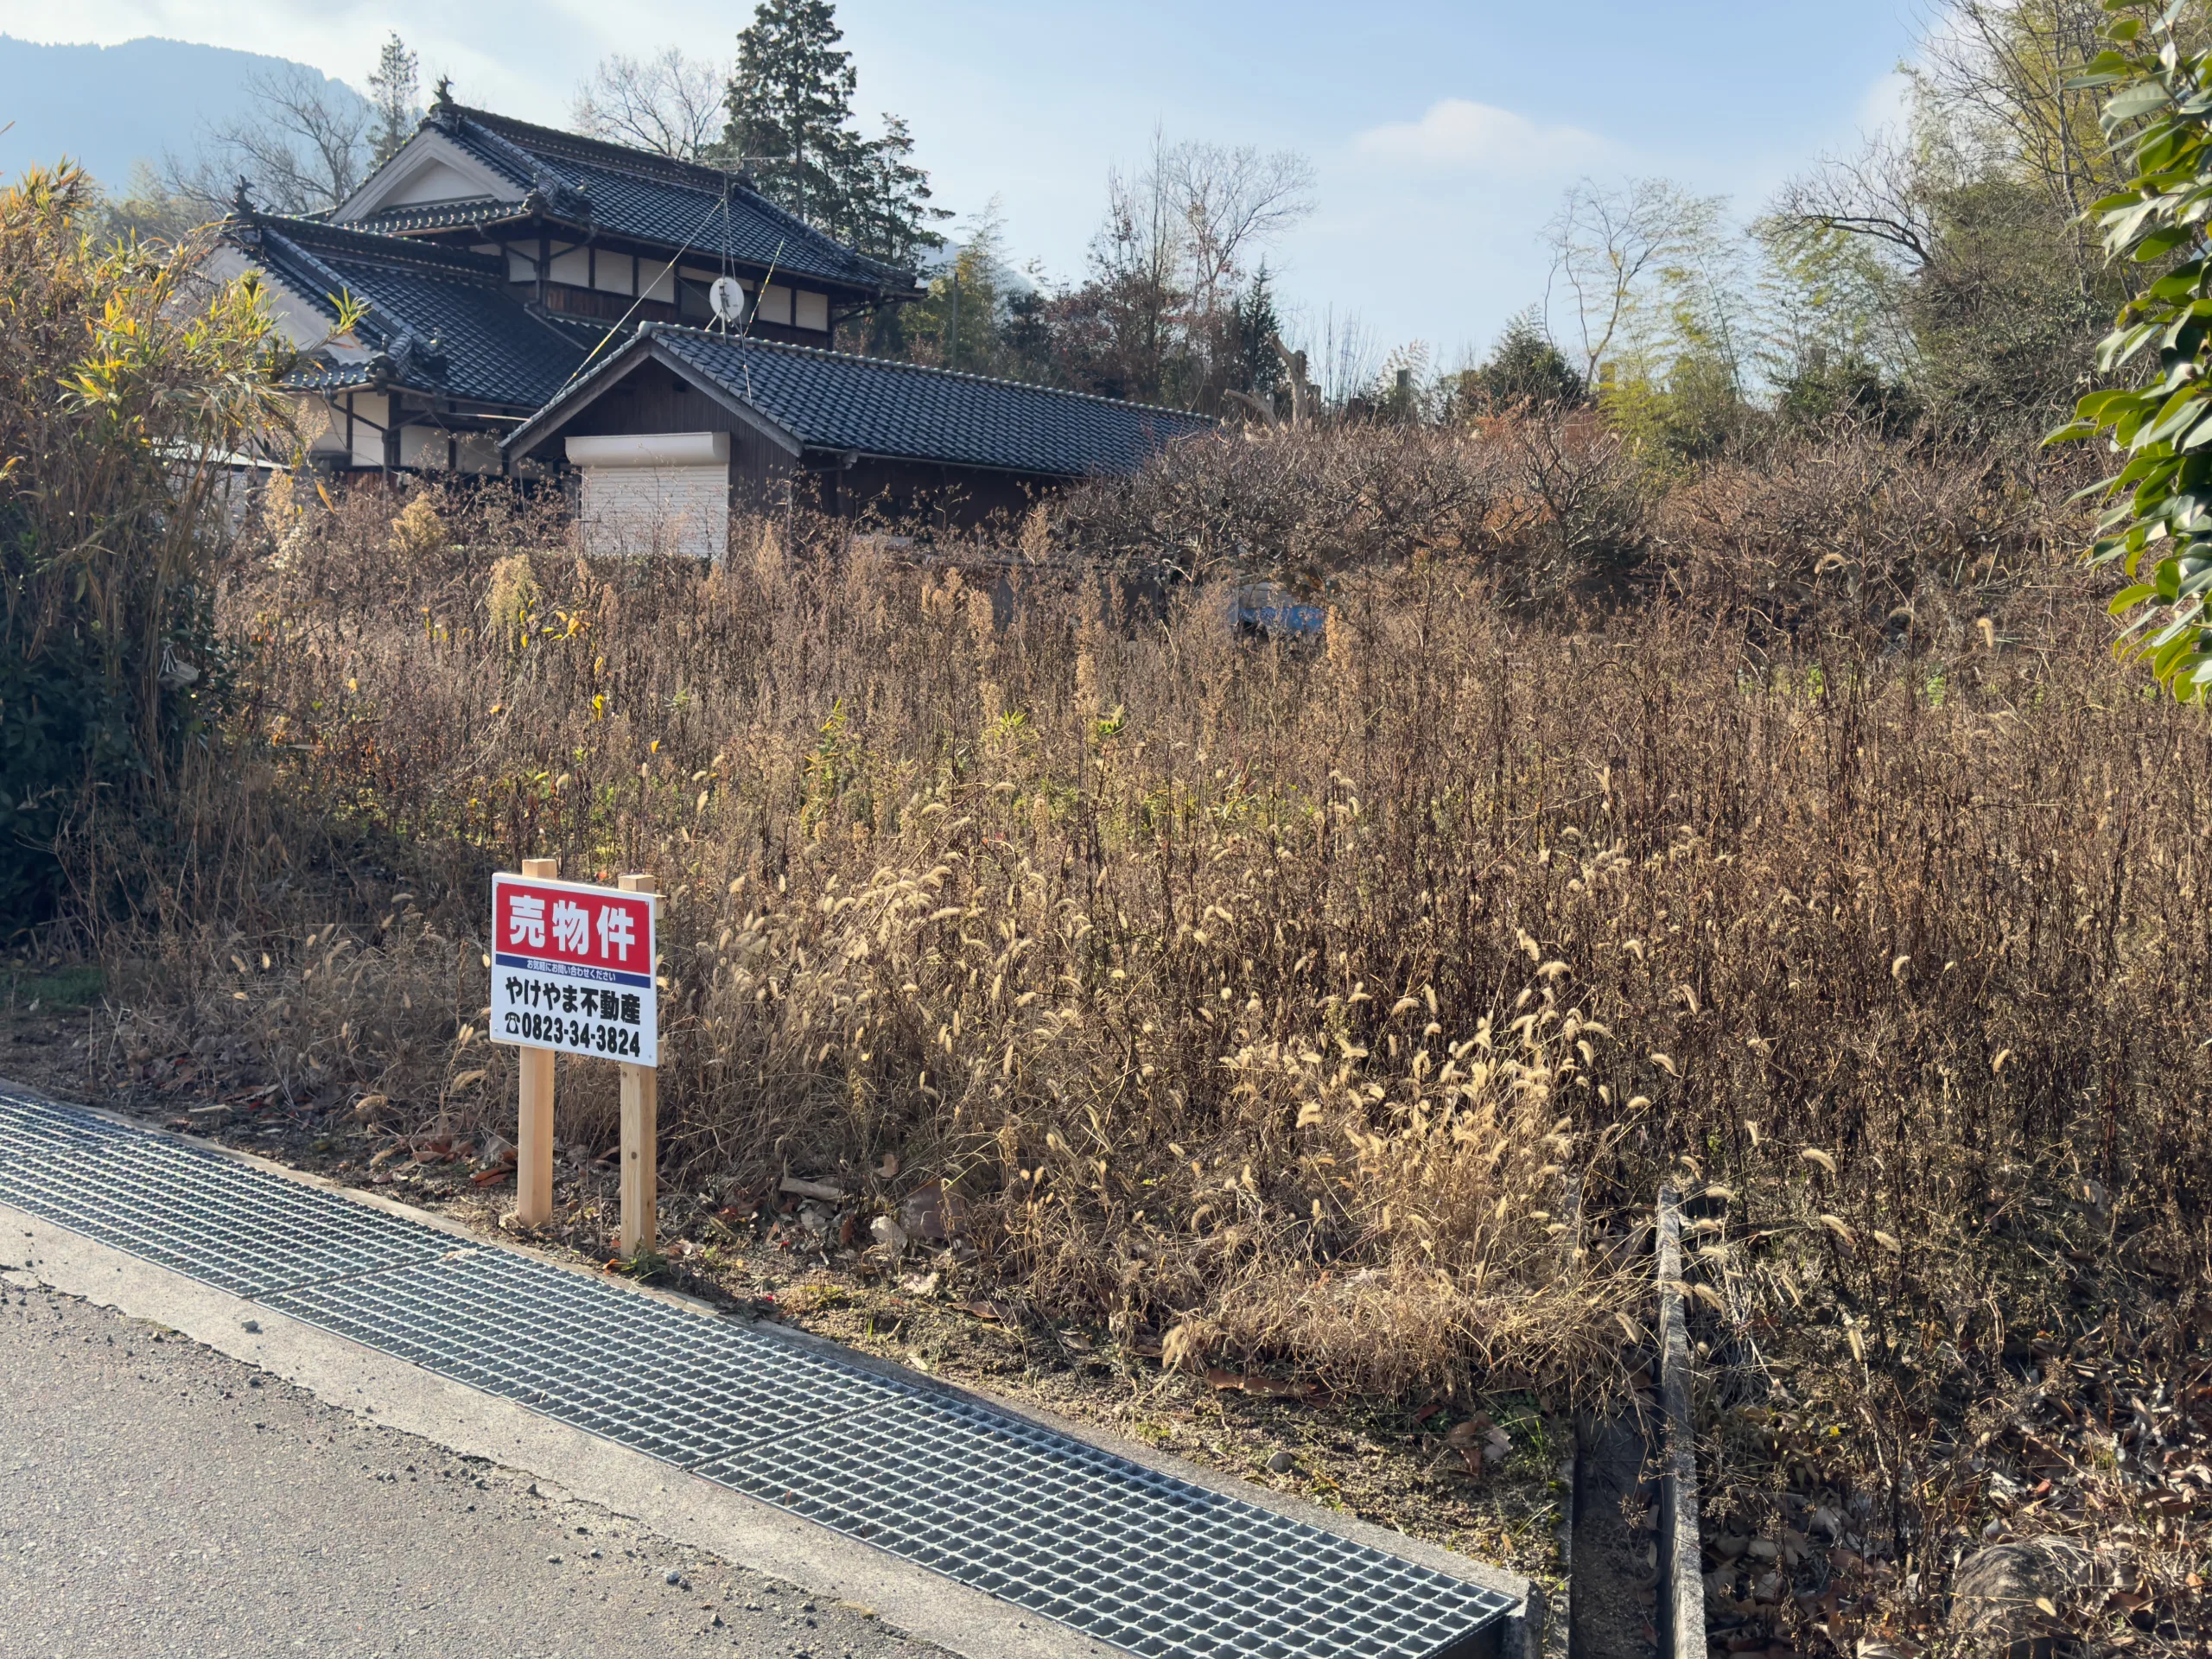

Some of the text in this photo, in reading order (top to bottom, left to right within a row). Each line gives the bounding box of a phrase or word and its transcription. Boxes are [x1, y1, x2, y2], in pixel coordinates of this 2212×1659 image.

[509, 894, 635, 962] 売物件
[526, 959, 616, 982] お気軽にお問い合わせください
[505, 976, 640, 1026] やけやま不動産
[521, 1012, 640, 1058] 0823-34-3824
